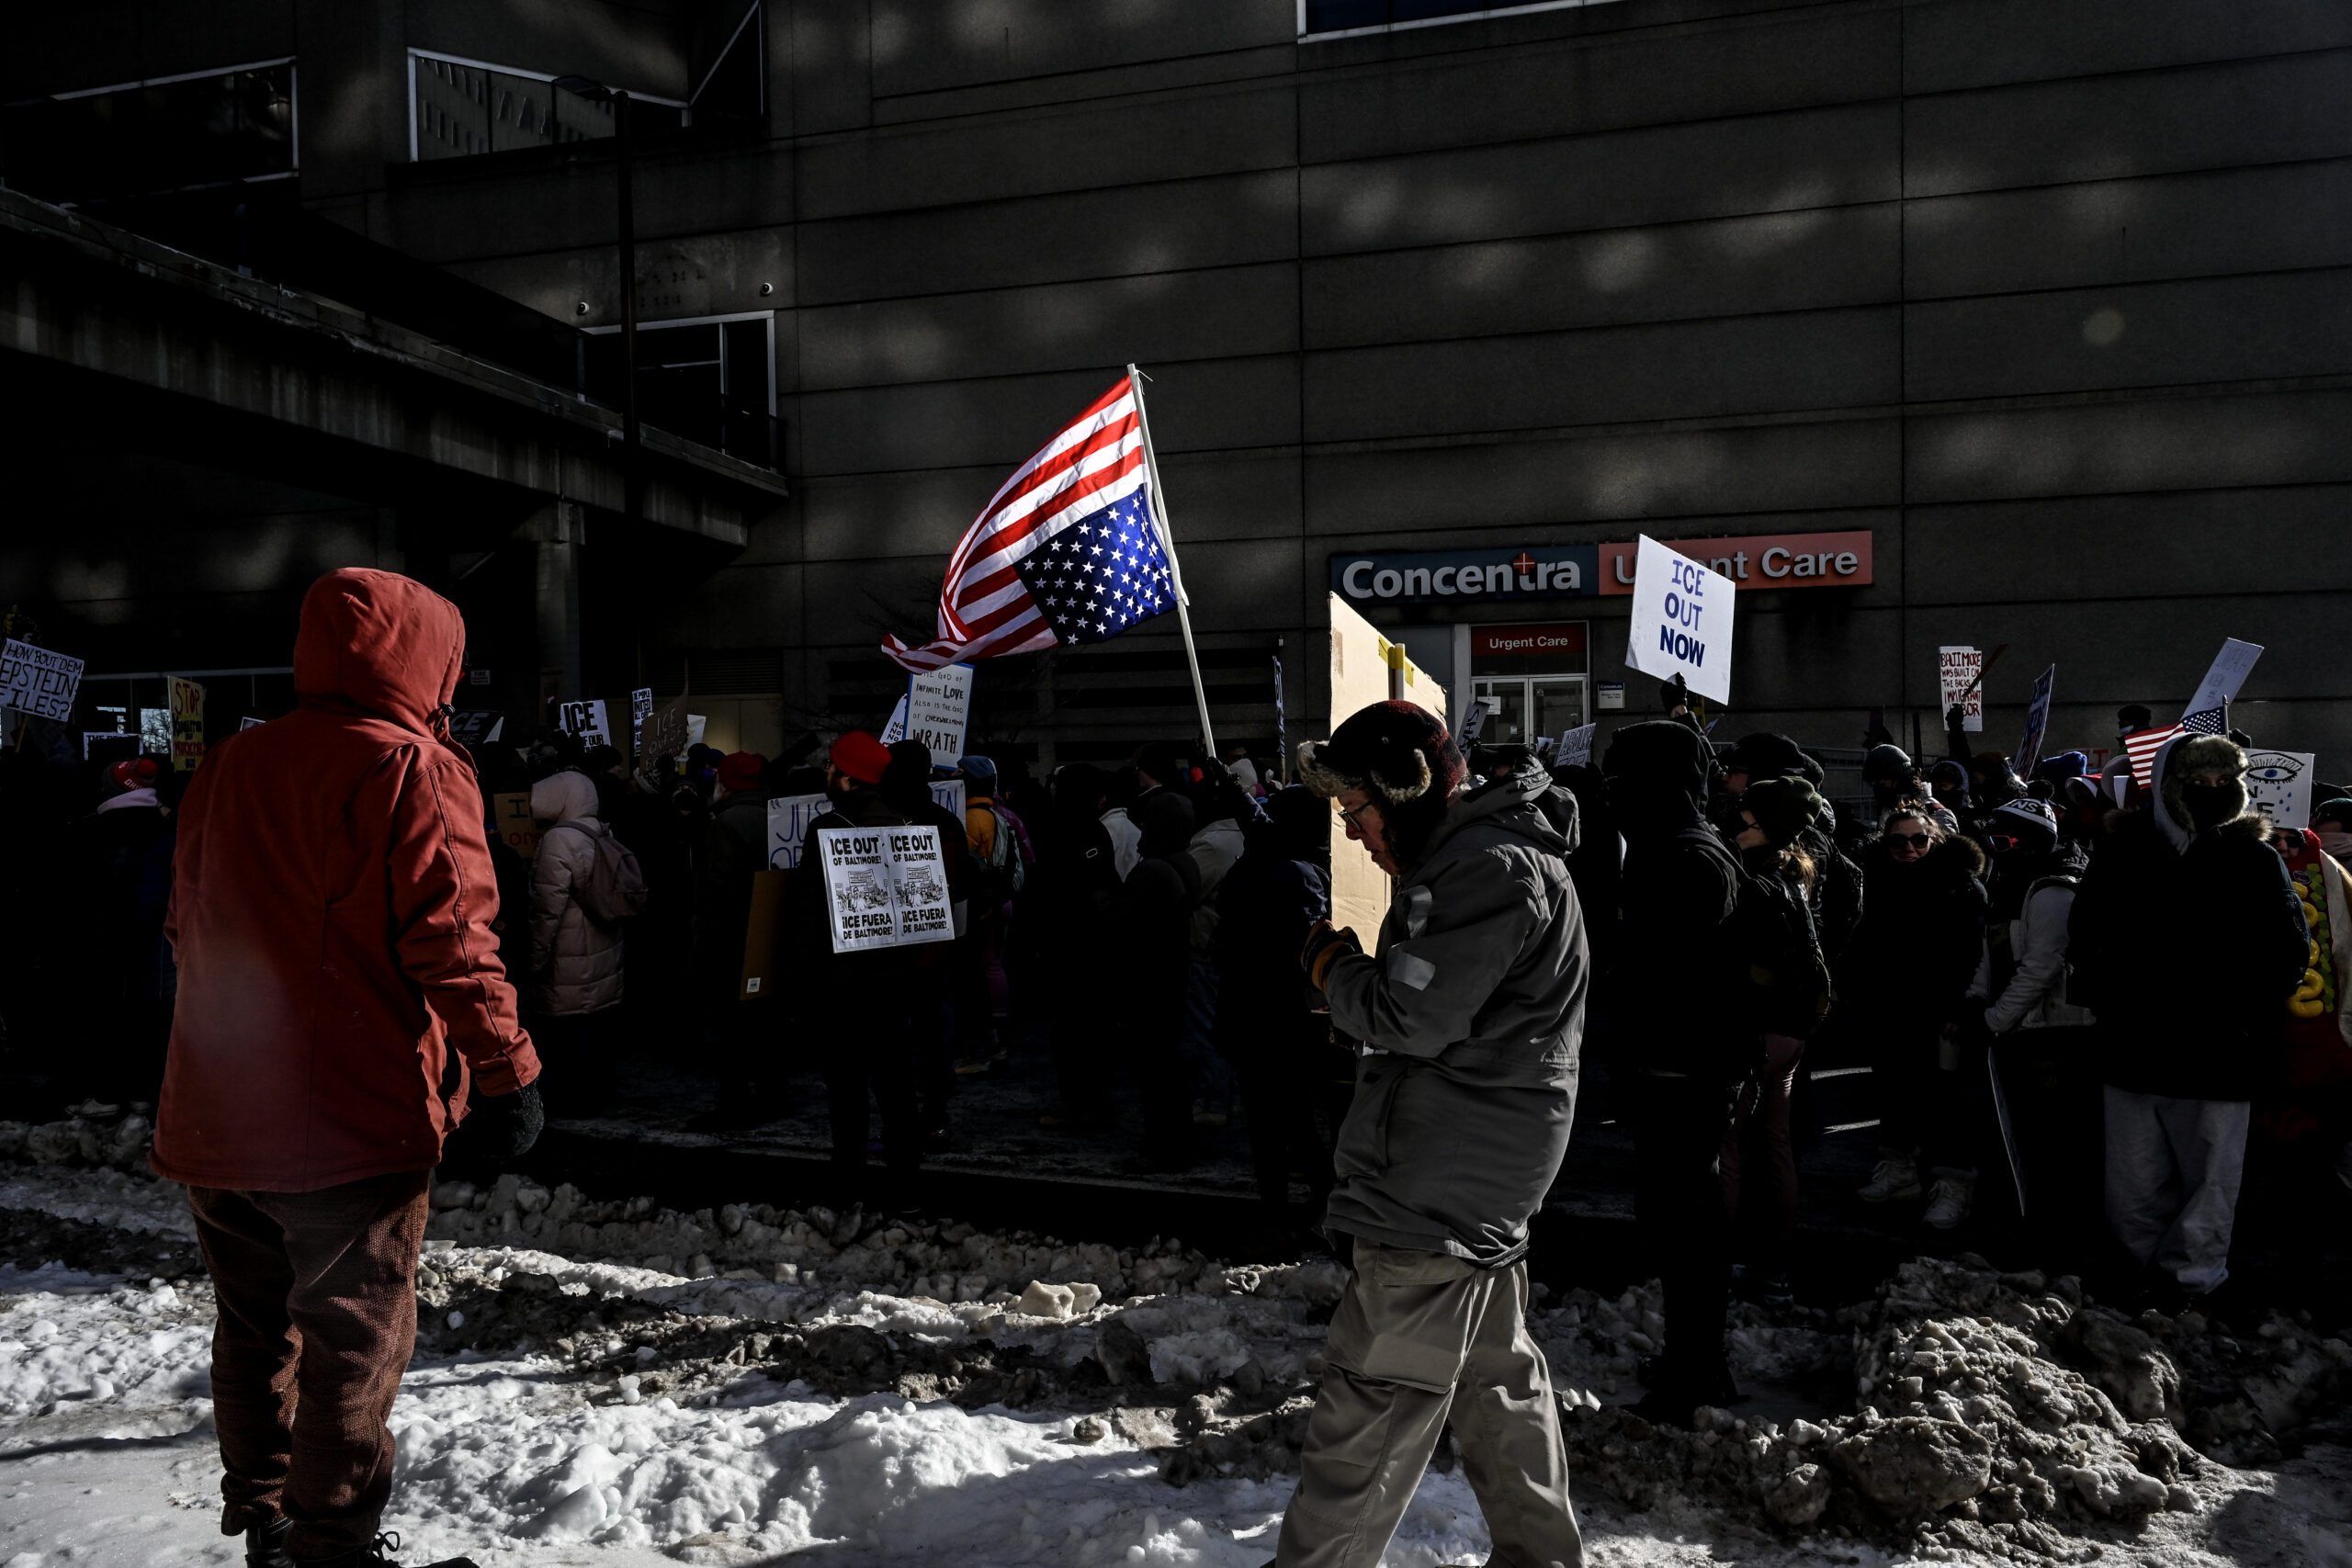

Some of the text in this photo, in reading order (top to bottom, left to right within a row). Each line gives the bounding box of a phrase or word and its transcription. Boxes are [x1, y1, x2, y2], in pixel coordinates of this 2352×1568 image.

[1615, 547, 1859, 584] Unt Care
[1342, 553, 1580, 599] Concentra
[1671, 559, 1705, 597] ICE
[1665, 592, 1702, 631] OUT
[1489, 636, 1568, 650] Urgent Care
[1659, 625, 1705, 668] NOW
[6, 643, 34, 661] HOW
[1942, 670, 1953, 678] WAS
[1954, 668, 1970, 678] BUILT
[916, 683, 964, 700] INFINITE LOVE
[1942, 679, 1953, 687] THE
[1955, 679, 1971, 687] BACKS
[175, 682, 200, 716] STOP
[942, 704, 951, 712] THE
[563, 703, 598, 733] ICE
[657, 707, 676, 736] ICE
[589, 734, 604, 746] OUR
[829, 837, 880, 855] ICE OUT
[889, 834, 934, 852] ICE OUT
[833, 855, 882, 866] OF BALTIMORE!
[893, 852, 937, 863] OF BALTIMORE!
[862, 913, 893, 927] FUERA
[920, 908, 946, 921] FUERA
[843, 926, 893, 940] DE BALTIMORE!
[903, 920, 947, 933] DE BALTIMORE!
